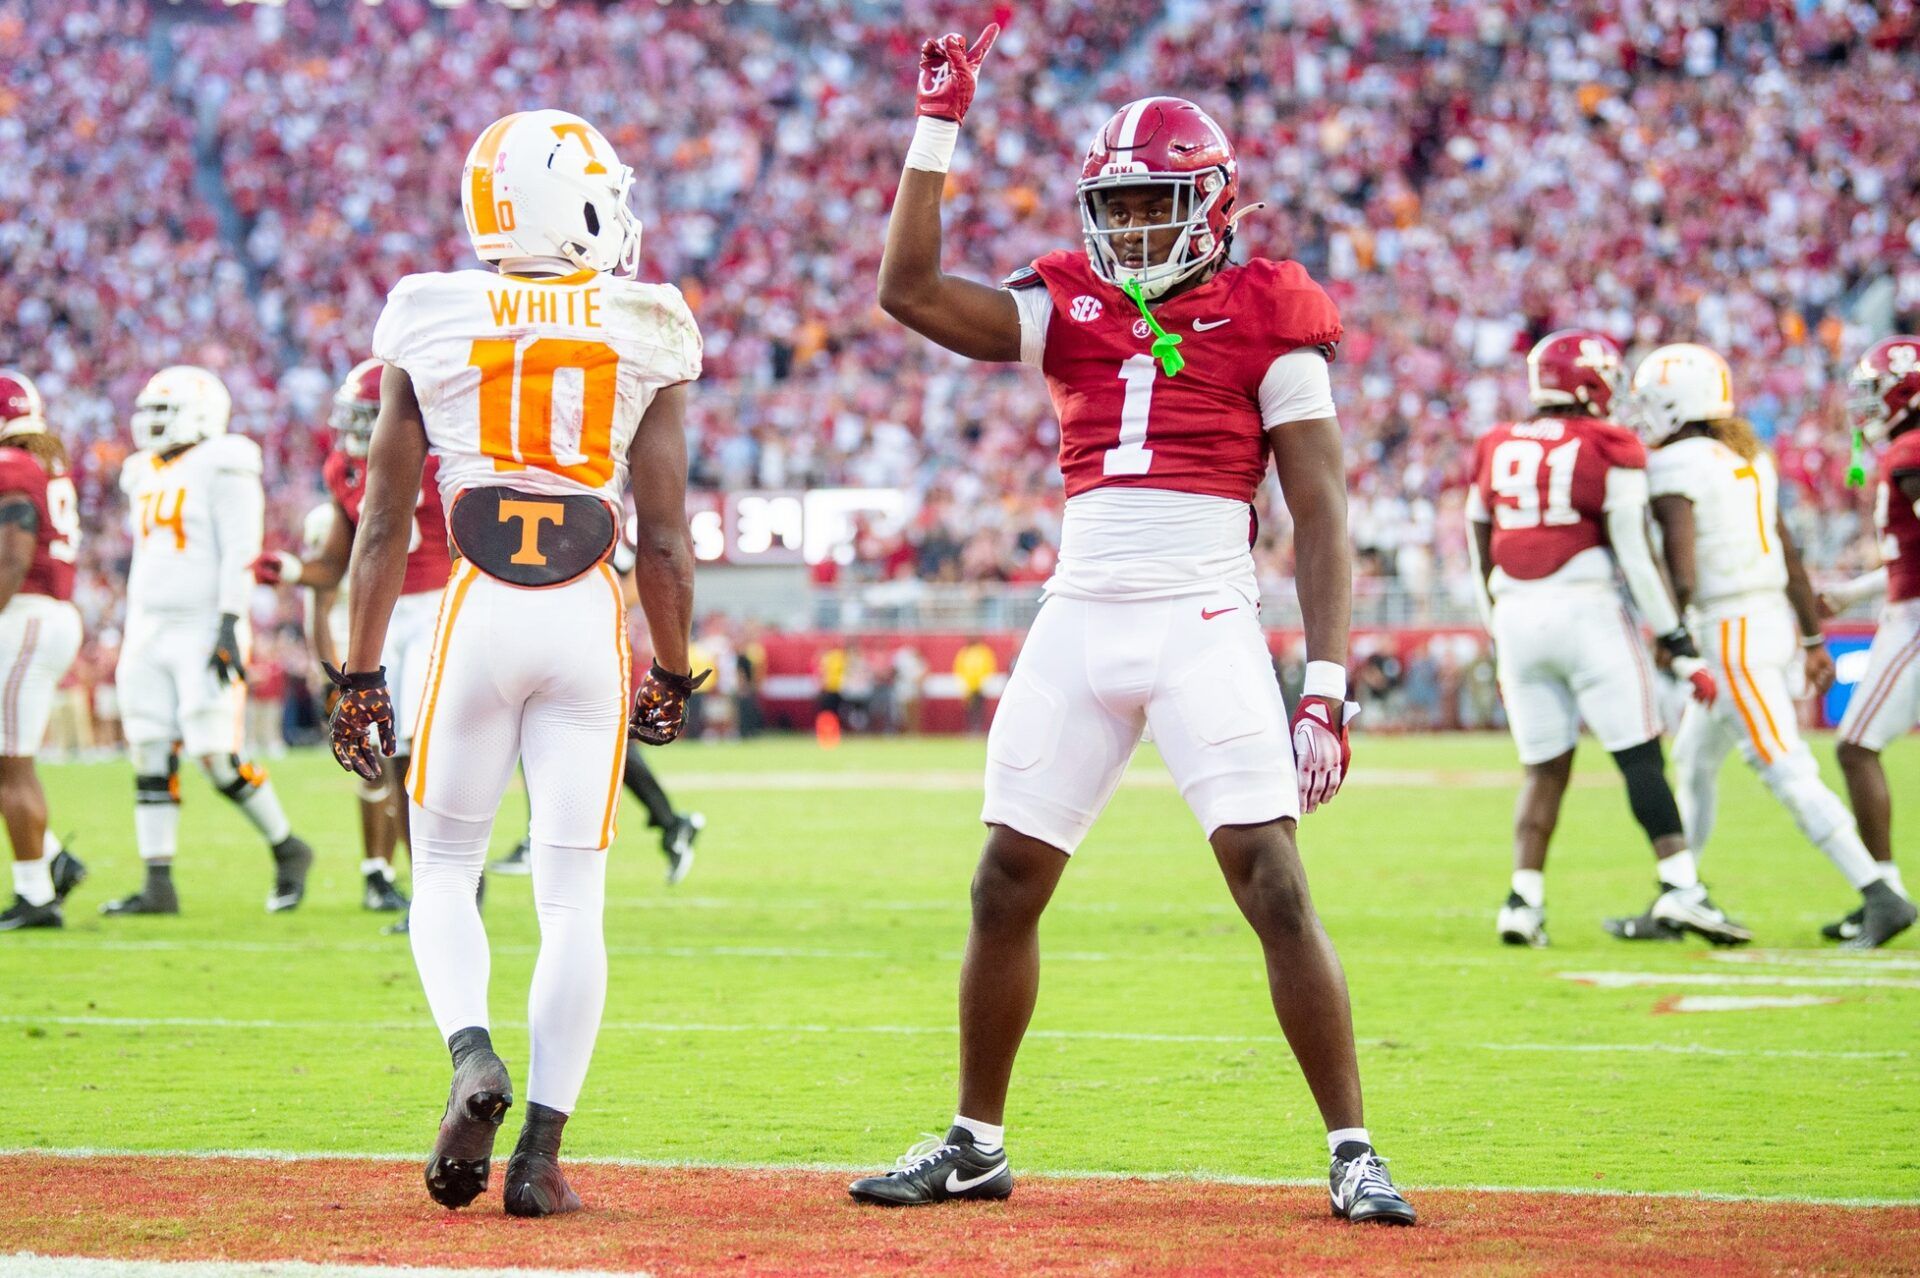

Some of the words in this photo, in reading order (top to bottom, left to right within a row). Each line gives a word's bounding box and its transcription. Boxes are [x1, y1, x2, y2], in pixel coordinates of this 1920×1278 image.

[1109, 165, 1134, 175] BAMA
[488, 288, 602, 327] WHITE
[1069, 295, 1103, 322] SEC
[467, 338, 620, 488] 10
[1103, 353, 1157, 476] 1
[1491, 437, 1582, 530] 91
[1733, 464, 1771, 555] 7
[498, 499, 565, 566] T
